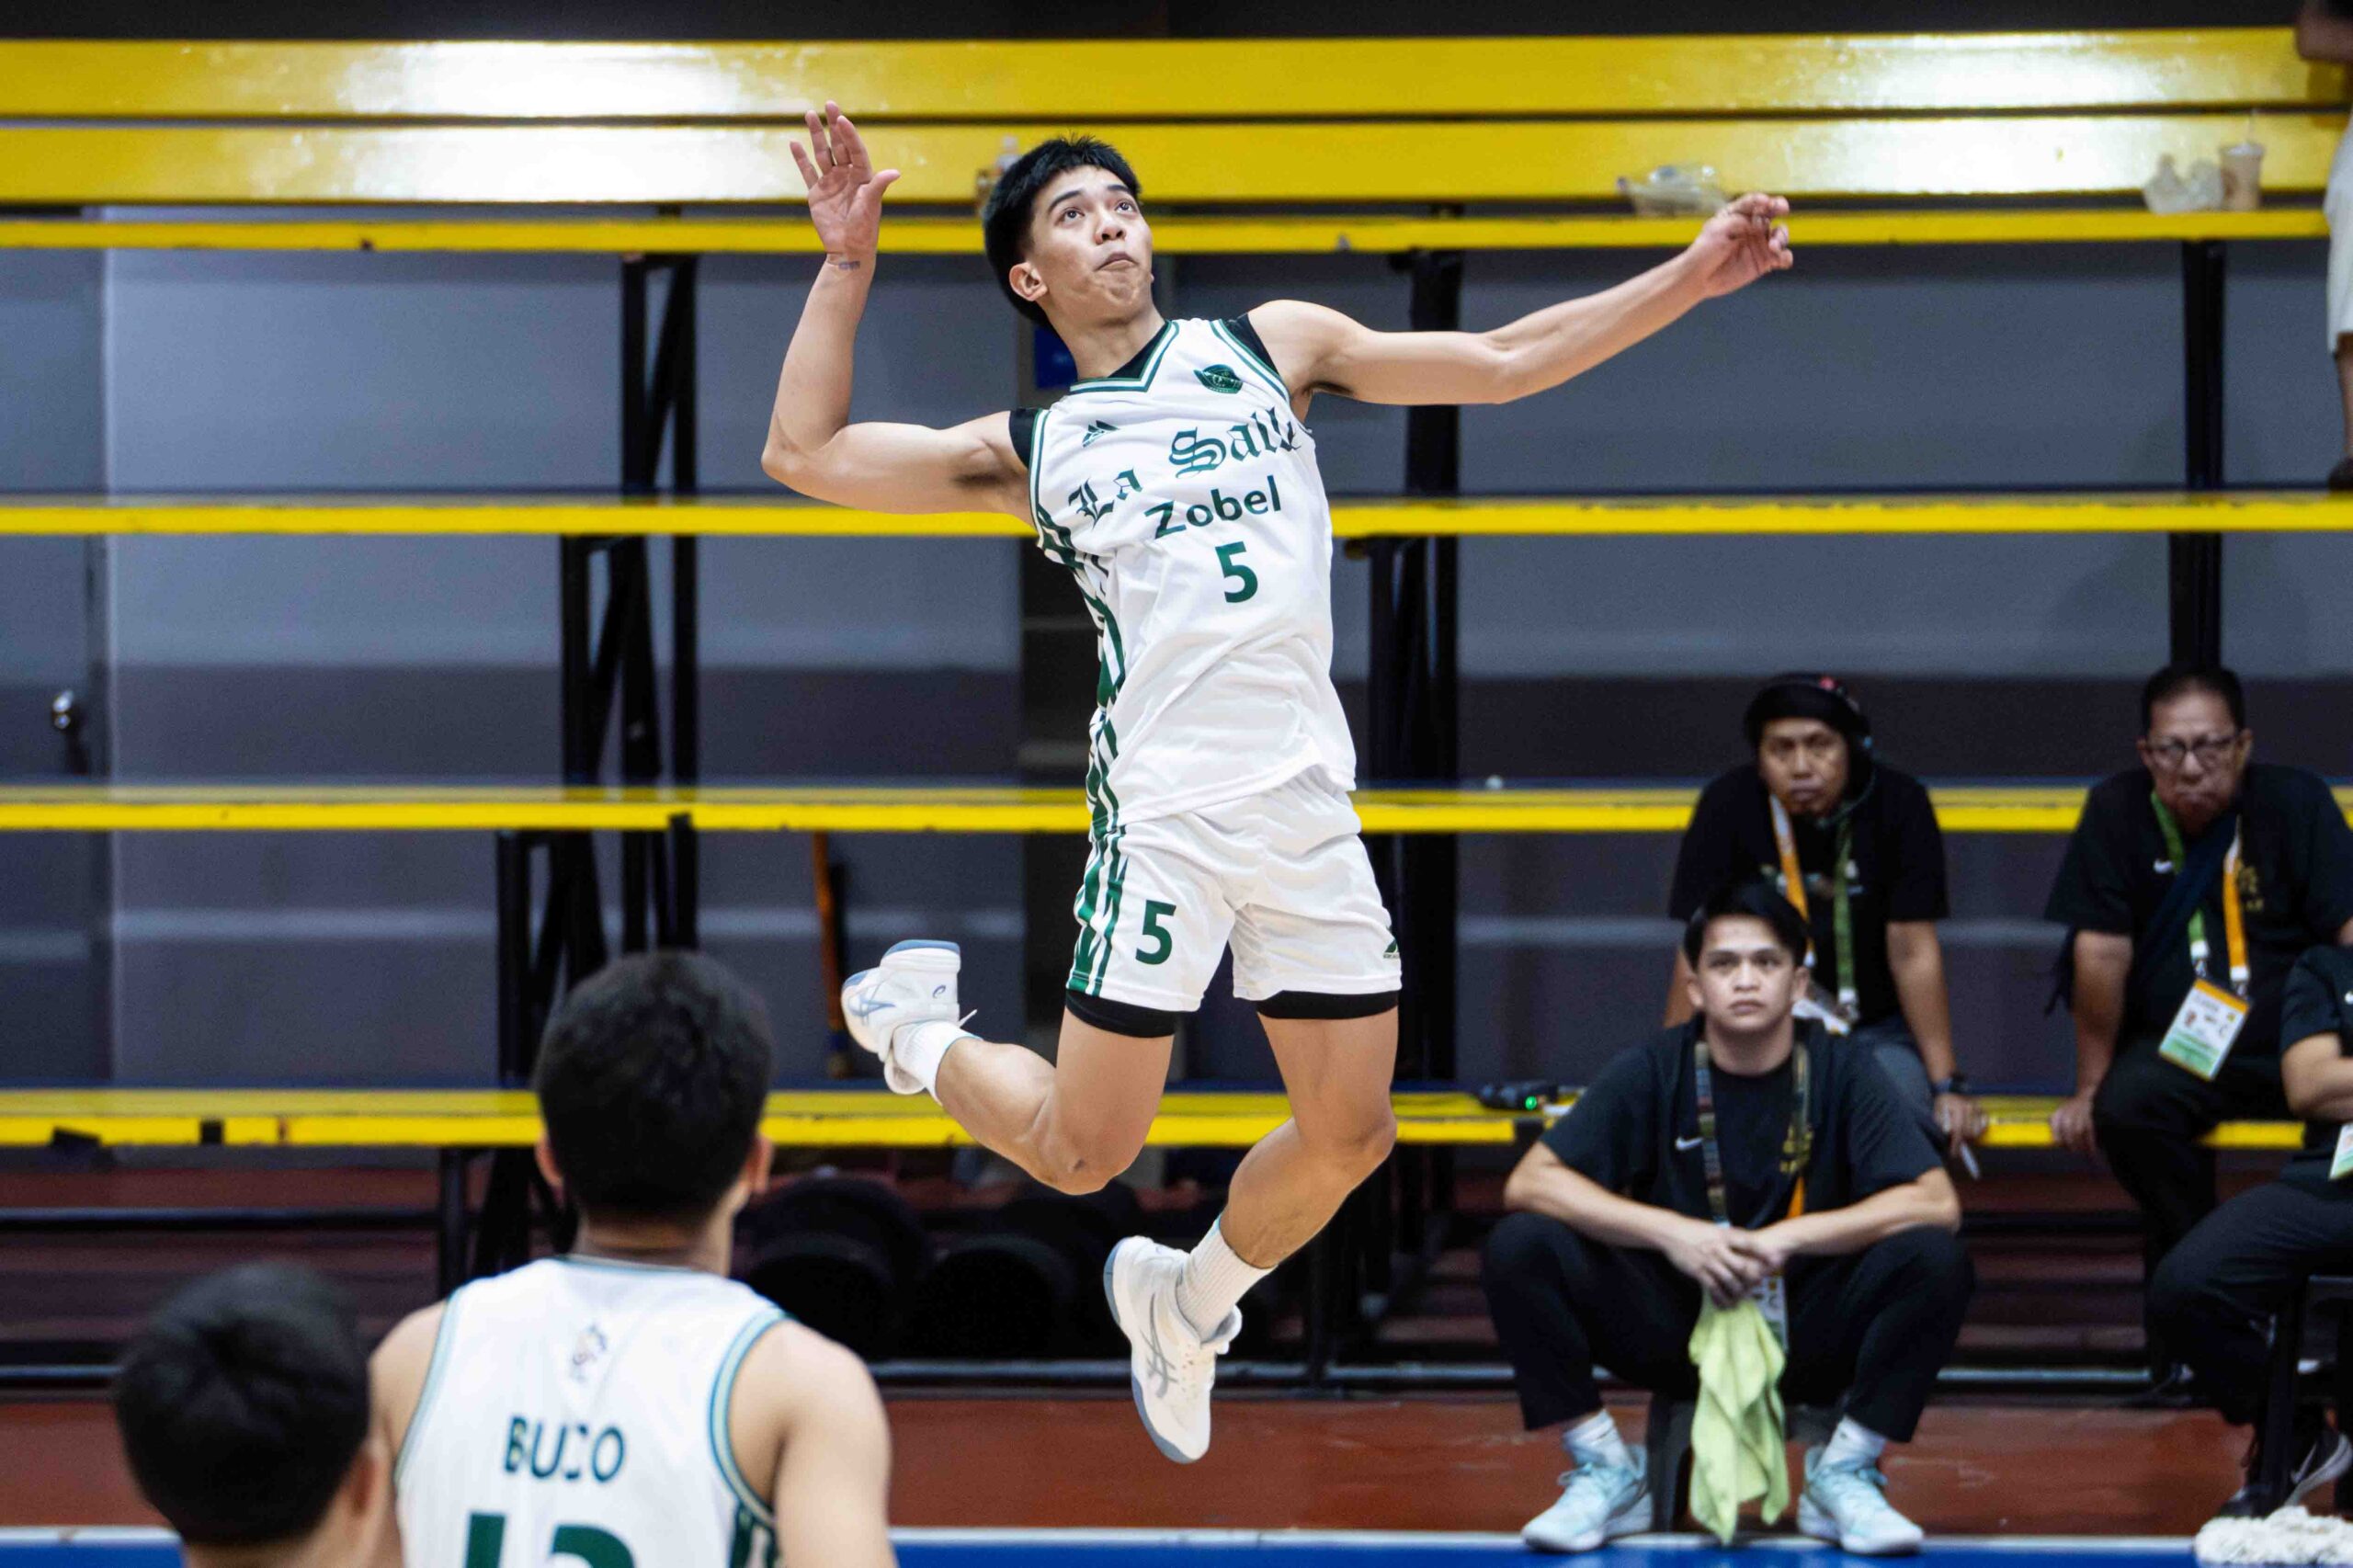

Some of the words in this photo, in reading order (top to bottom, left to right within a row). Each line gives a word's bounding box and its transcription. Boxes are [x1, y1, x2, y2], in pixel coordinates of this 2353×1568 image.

[1068, 468, 1143, 531] La
[1143, 474, 1283, 540] Zobel
[1215, 540, 1259, 604] 5
[1135, 899, 1176, 966] 5
